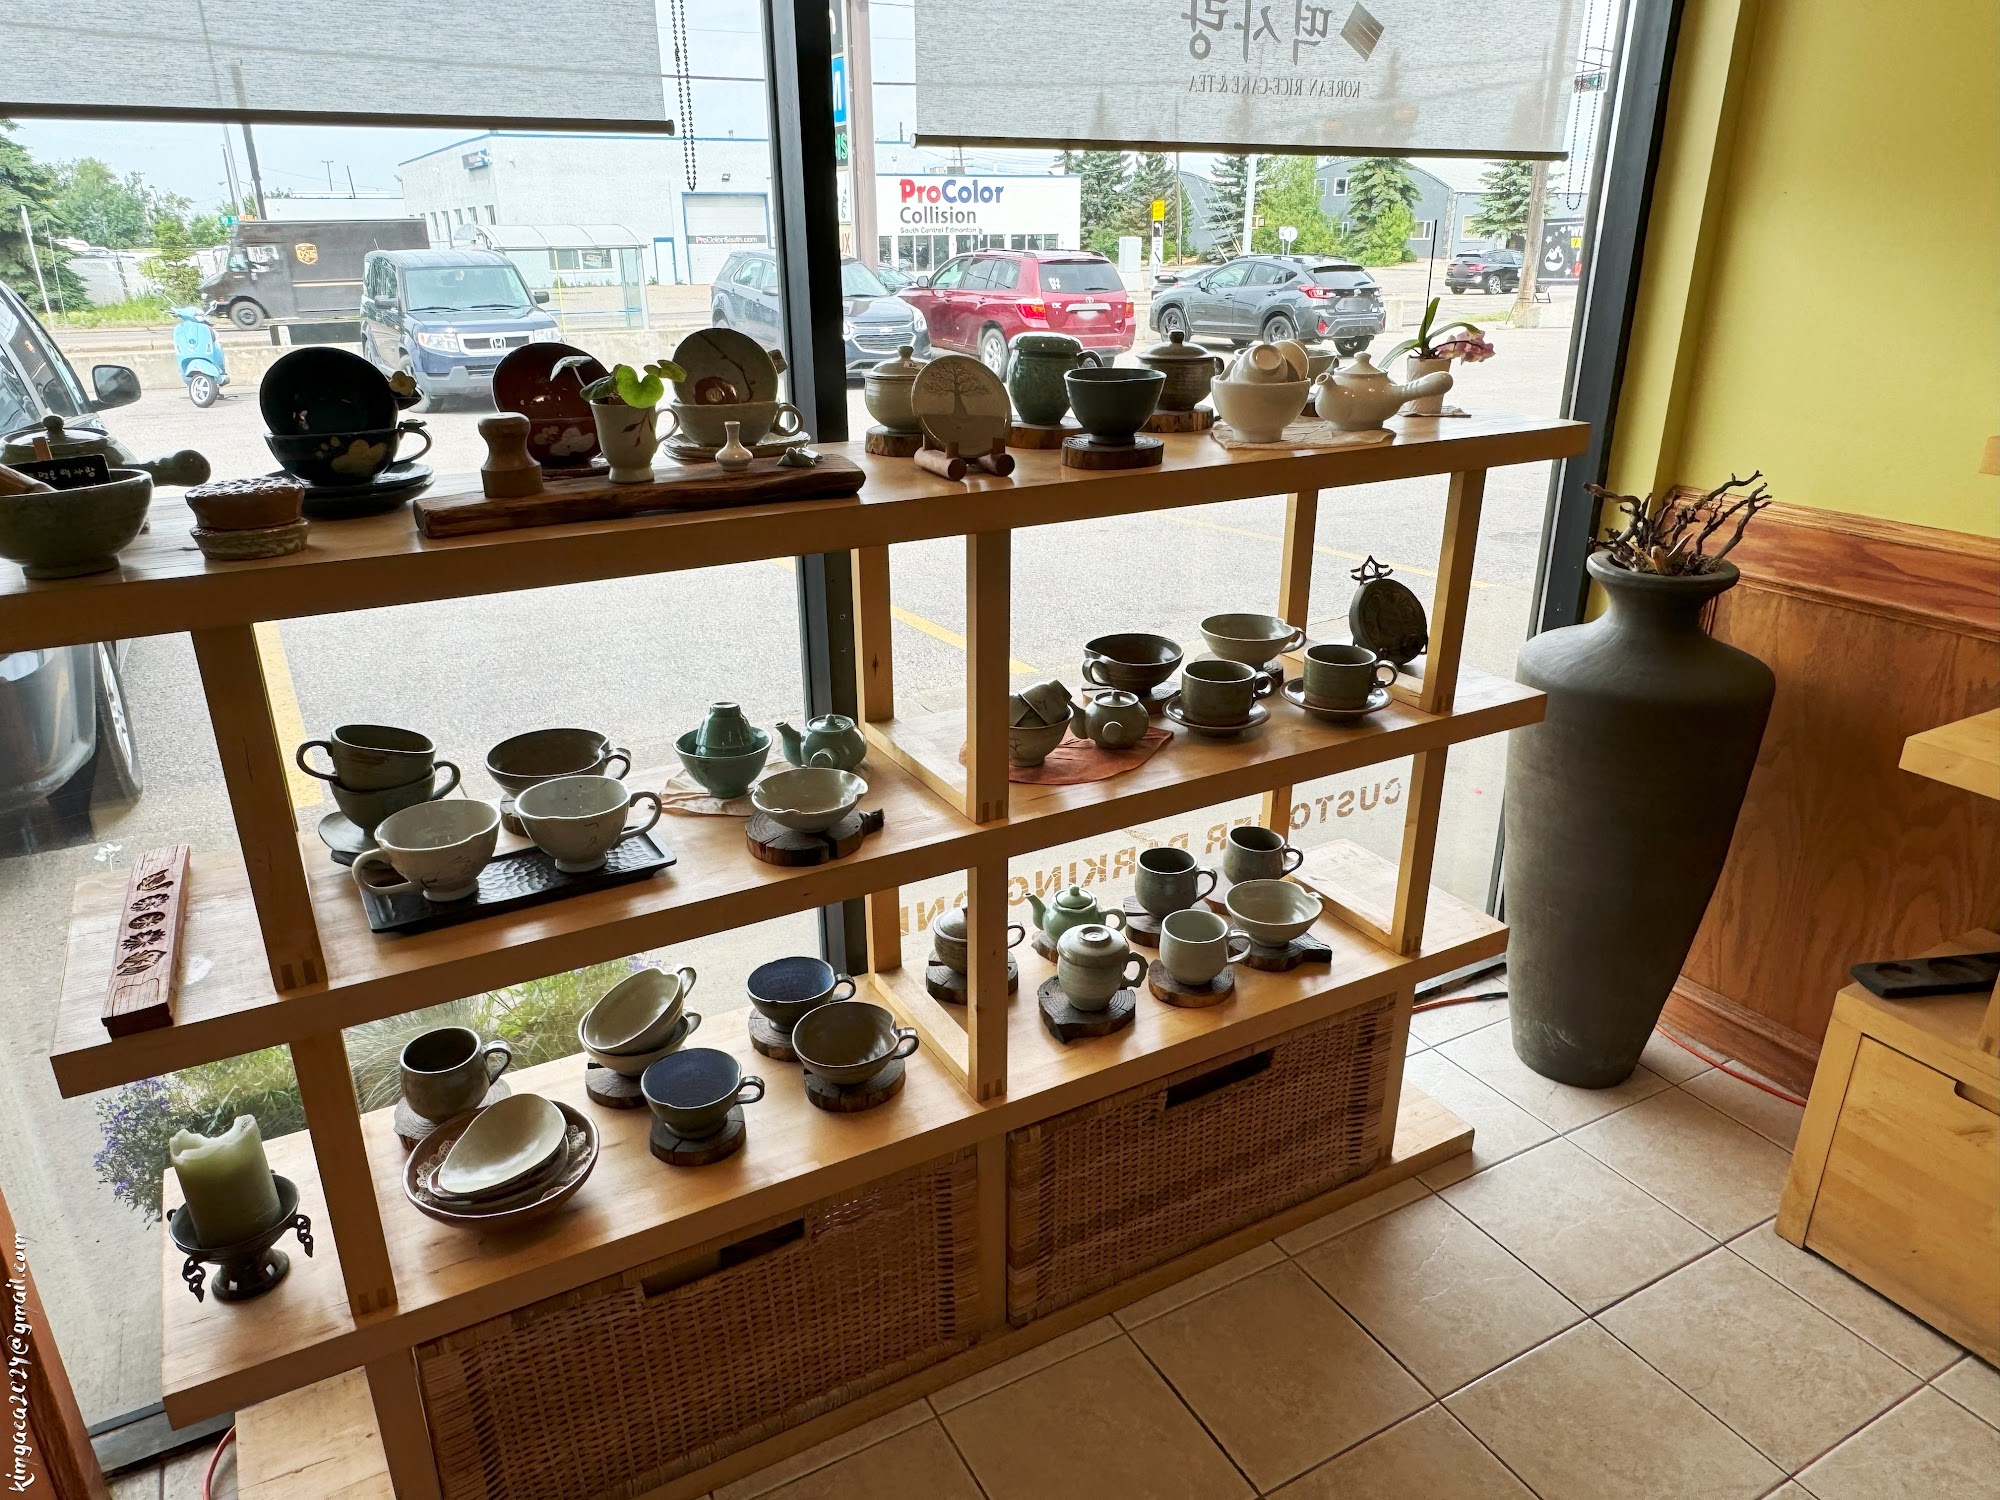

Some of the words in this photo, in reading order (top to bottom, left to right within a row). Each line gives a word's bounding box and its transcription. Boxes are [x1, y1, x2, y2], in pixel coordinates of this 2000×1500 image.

[899, 178, 1005, 204] ProColor
[900, 206, 977, 224] Collision
[945, 226, 977, 234] Edmonton
